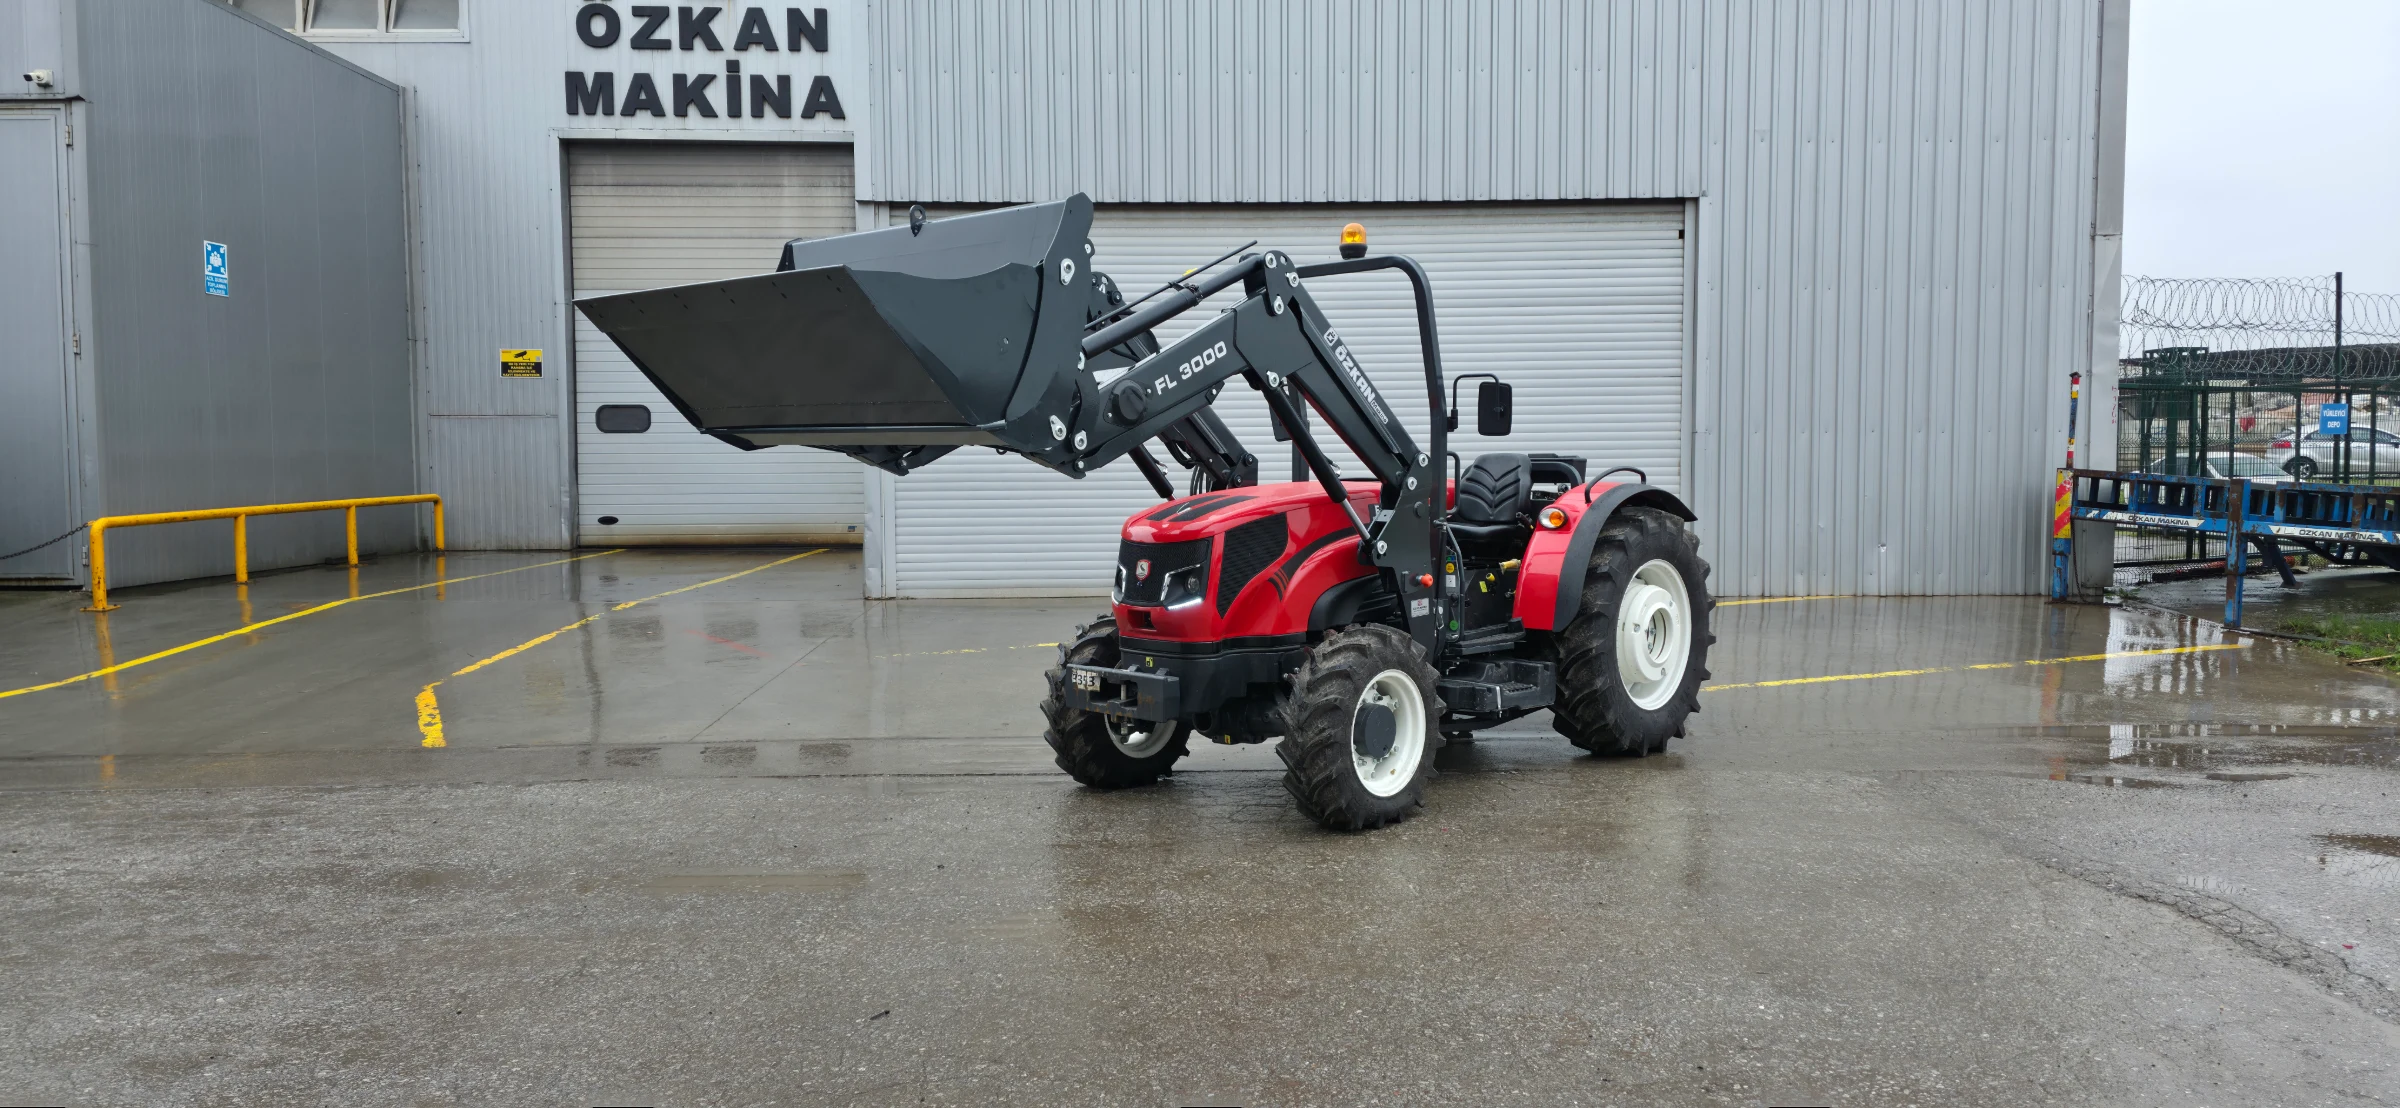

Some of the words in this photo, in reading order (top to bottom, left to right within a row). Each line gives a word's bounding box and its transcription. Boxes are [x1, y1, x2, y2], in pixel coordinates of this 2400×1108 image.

[575, 0, 829, 51] ÖZKAN
[565, 60, 846, 120] MAKİNA
[1154, 374, 1178, 395] FL
[1179, 341, 1227, 380] 3000
[1335, 345, 1375, 402] ÖZKAN
